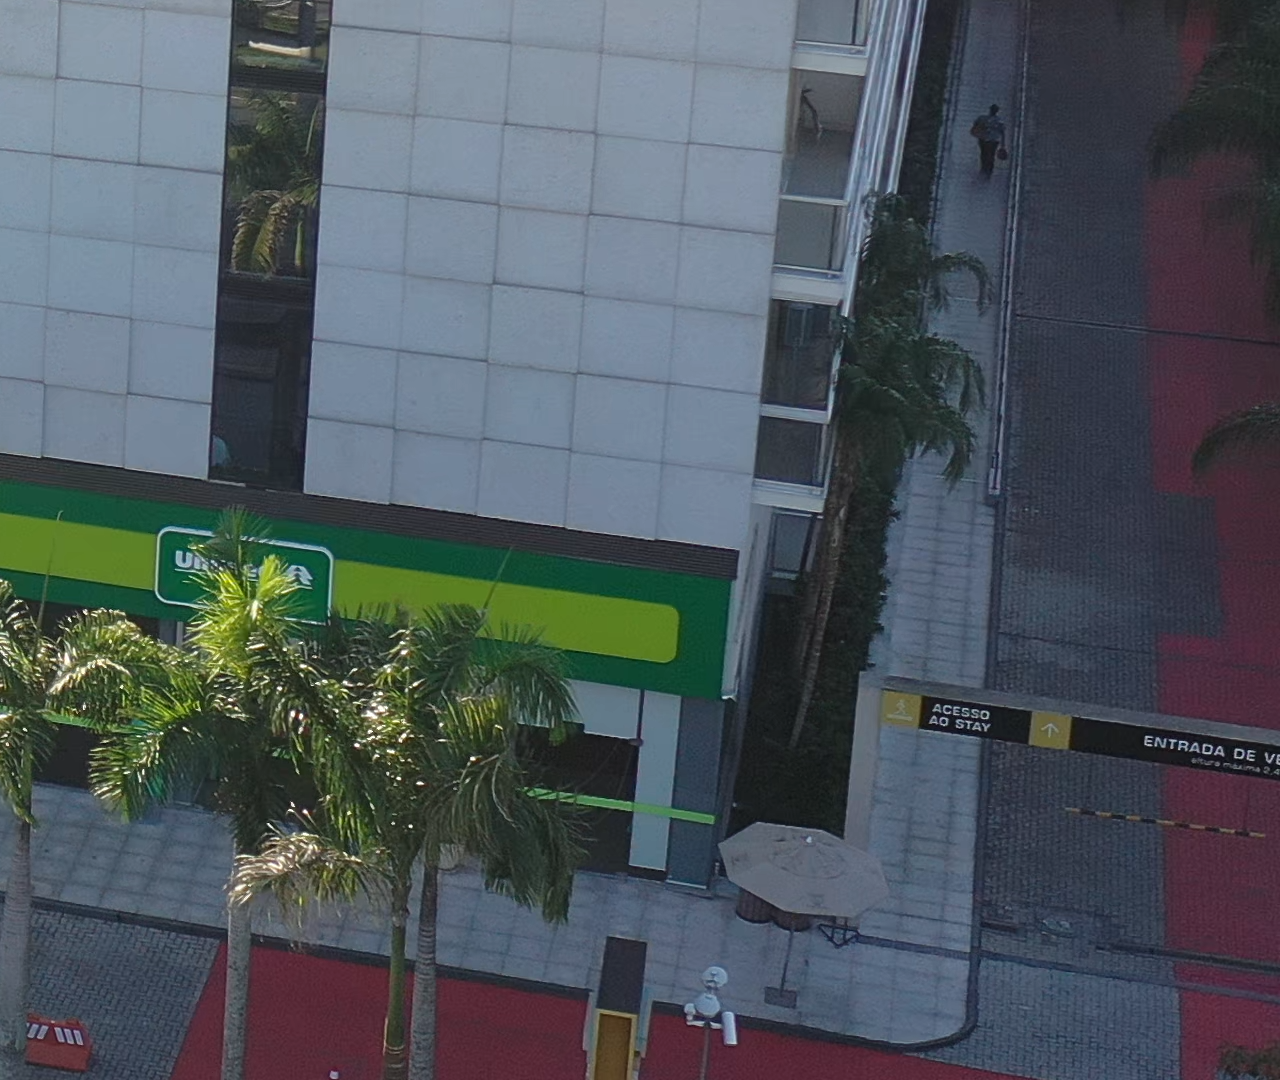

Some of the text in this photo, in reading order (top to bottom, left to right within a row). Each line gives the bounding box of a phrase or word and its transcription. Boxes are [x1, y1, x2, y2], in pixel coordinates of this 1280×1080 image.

[931, 703, 991, 720] ACESSO
[928, 715, 992, 732] AO STAY
[1143, 735, 1225, 758] ENTRADA
[1233, 747, 1257, 762] DE
